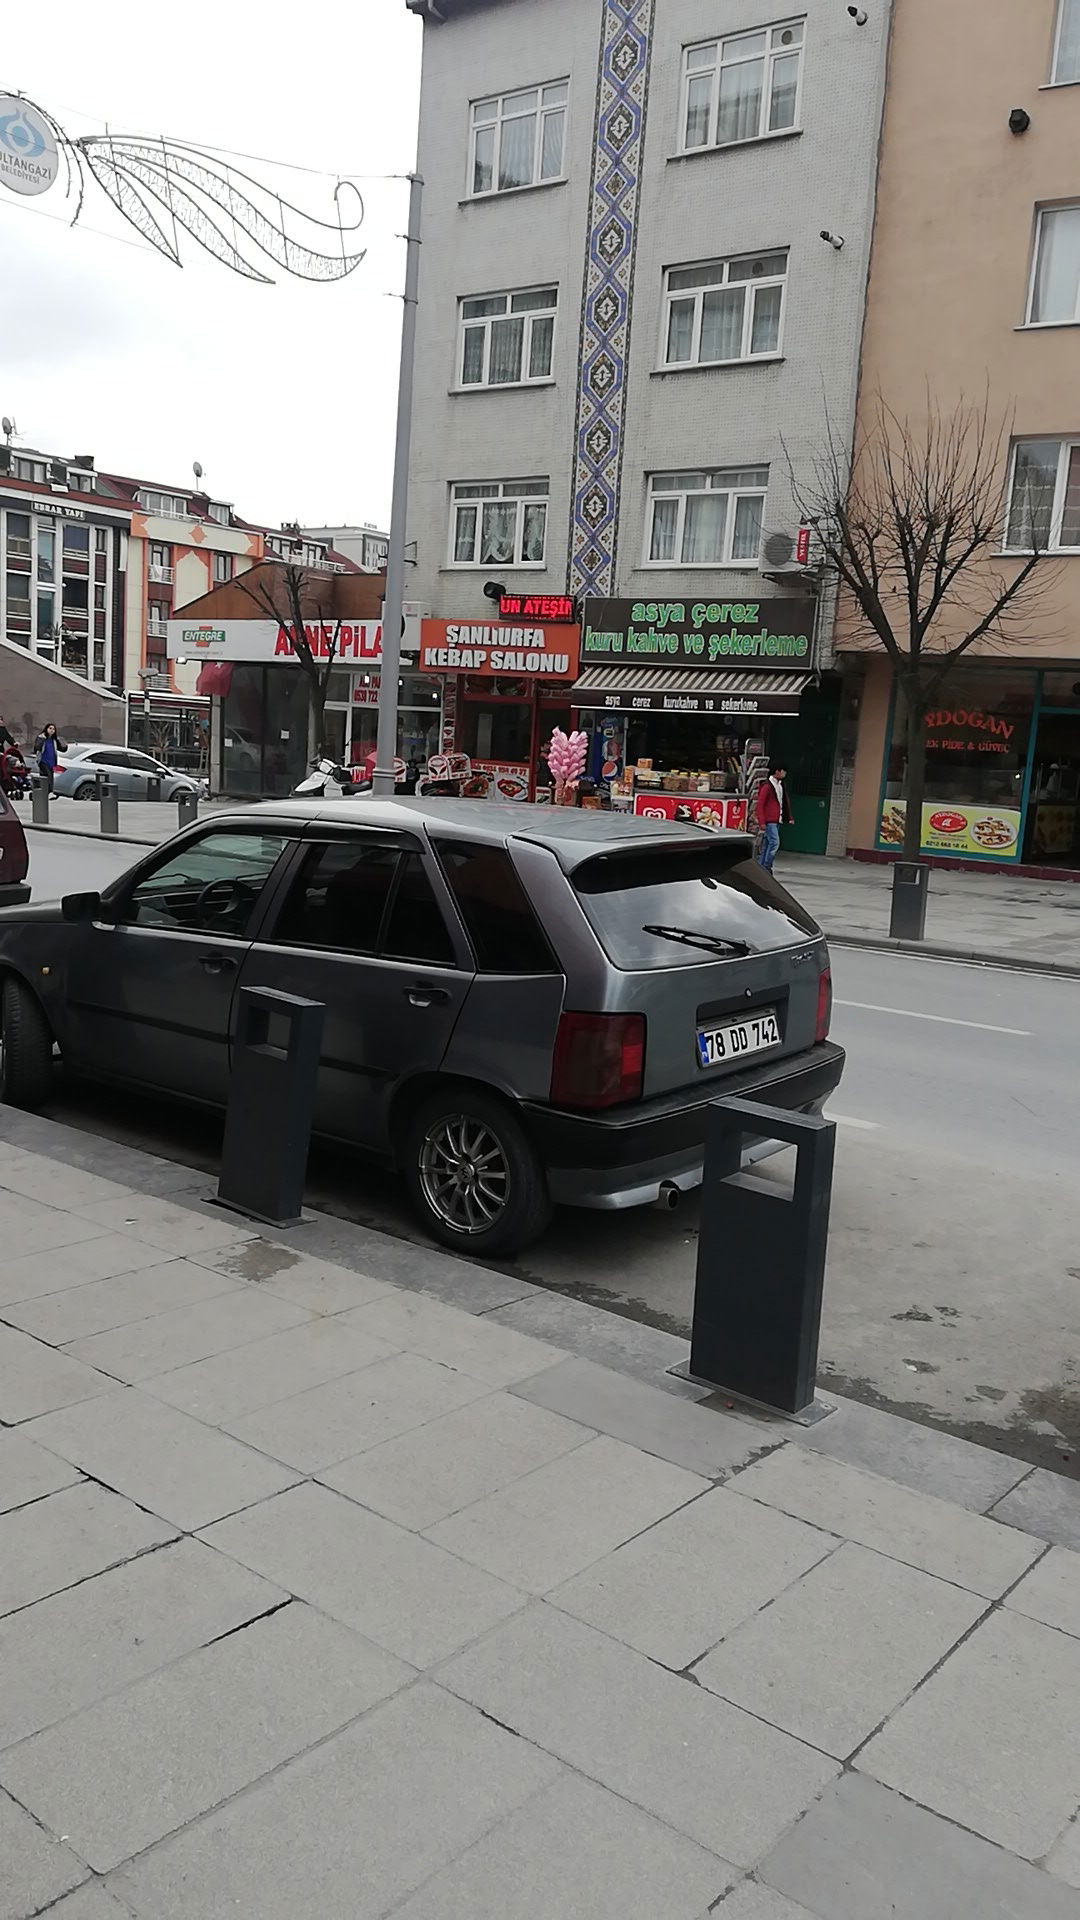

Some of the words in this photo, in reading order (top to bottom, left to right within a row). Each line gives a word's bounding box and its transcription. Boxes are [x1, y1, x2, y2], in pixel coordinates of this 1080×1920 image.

[34, 502, 62, 515] EBRAR
[64, 508, 84, 518] YAPI
[632, 602, 685, 628] asya
[691, 602, 760, 629] çerez
[184, 631, 223, 641] ENTEGRE
[584, 626, 623, 652] kuru
[626, 627, 679, 653] kahve
[683, 633, 704, 654] ve
[708, 628, 808, 661] şekerleme
[424, 647, 487, 668] KEBAP
[490, 650, 569, 673] SALONU
[605, 696, 621, 708] asya
[705, 699, 714, 710] ve
[704, 1032, 726, 1060] 78
[729, 1027, 748, 1053] DD
[752, 1018, 778, 1047] 742
